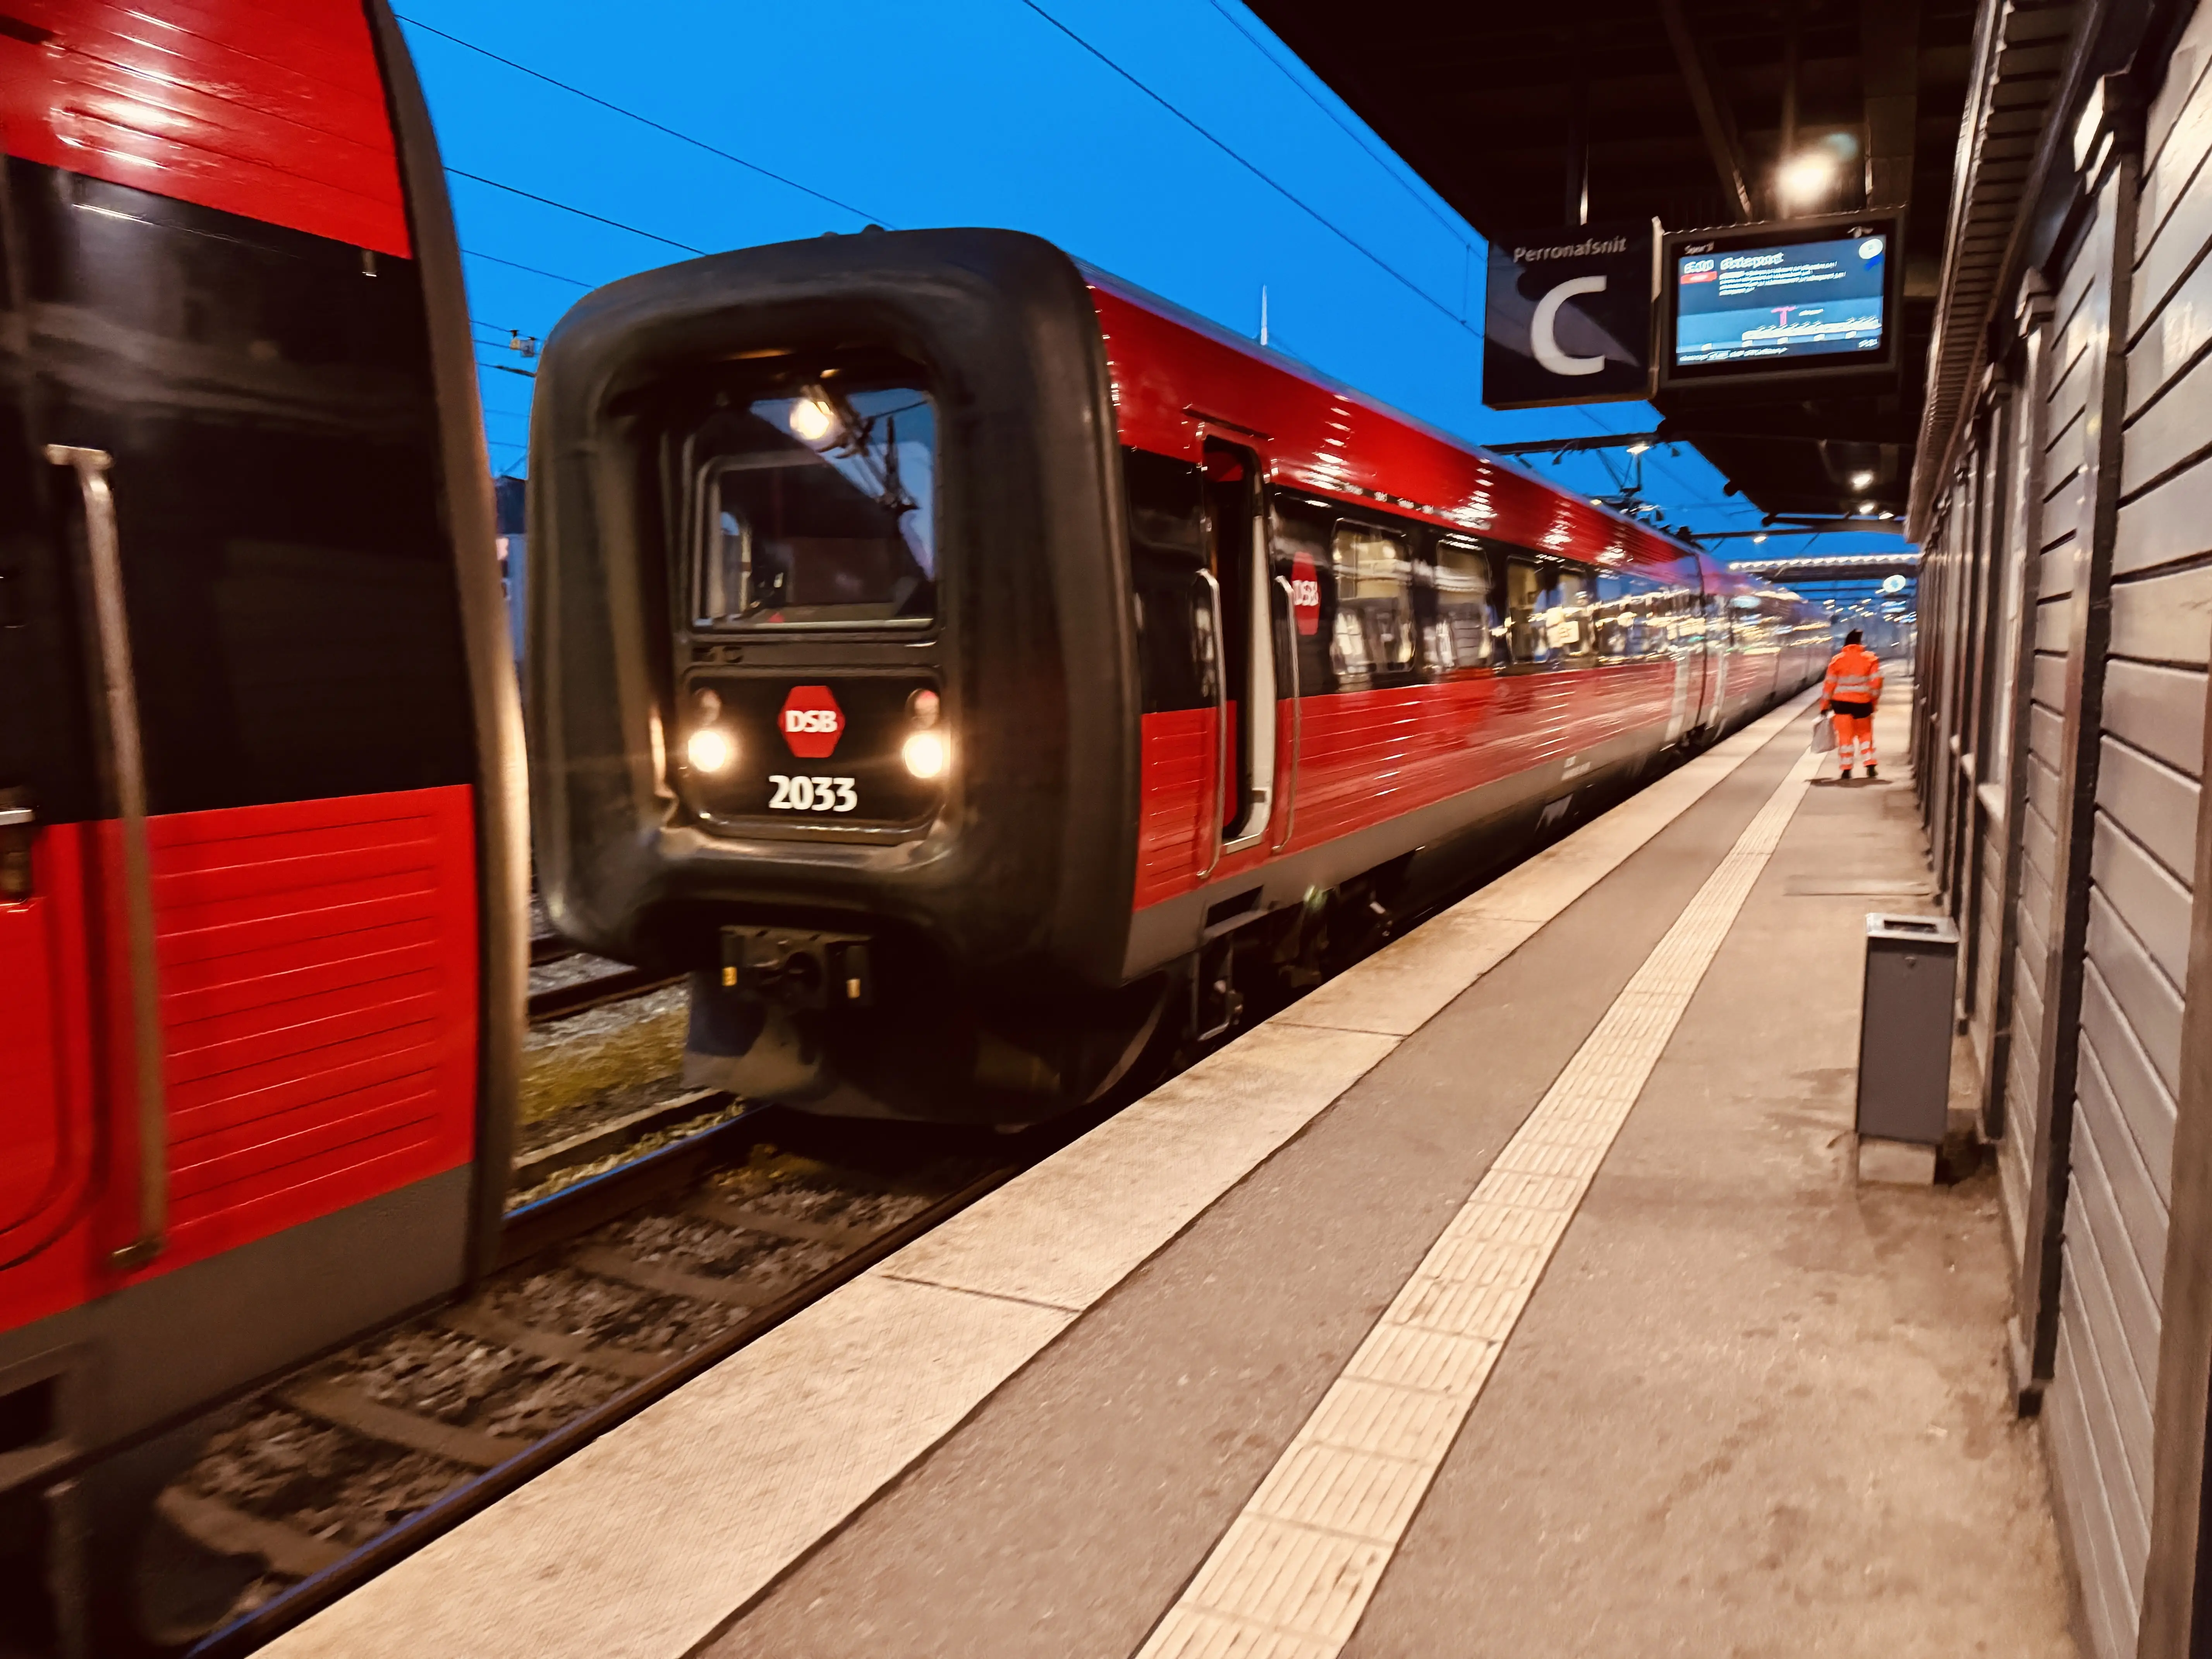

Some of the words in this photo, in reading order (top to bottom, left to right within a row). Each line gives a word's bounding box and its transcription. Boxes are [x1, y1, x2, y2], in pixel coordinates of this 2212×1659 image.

[1513, 235, 1626, 263] Perronafsnit
[1531, 275, 1607, 376] C
[786, 710, 838, 733] DSB
[769, 775, 858, 812] 2033
